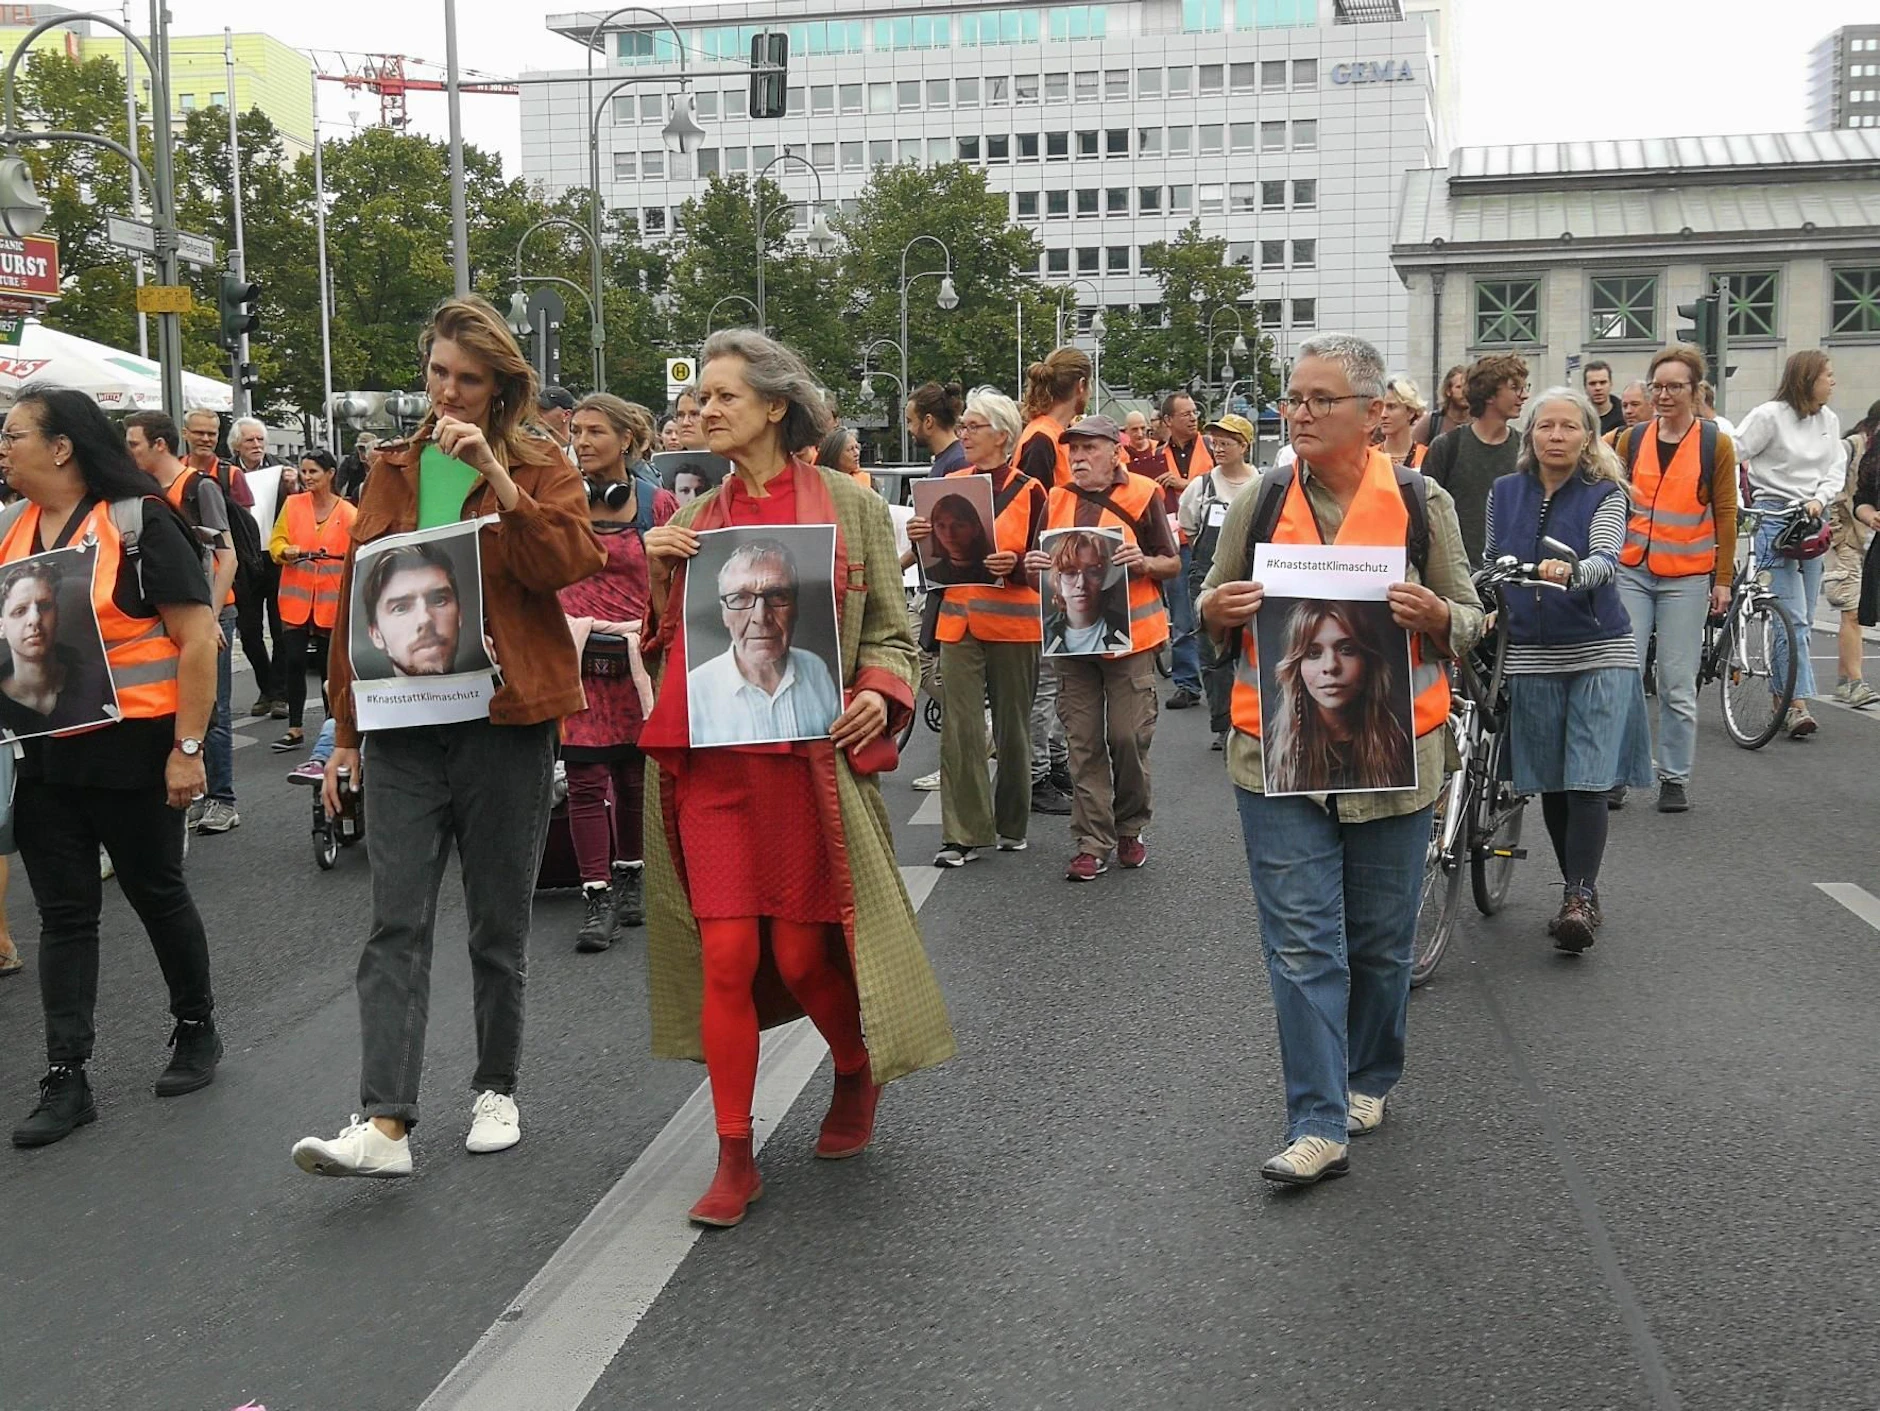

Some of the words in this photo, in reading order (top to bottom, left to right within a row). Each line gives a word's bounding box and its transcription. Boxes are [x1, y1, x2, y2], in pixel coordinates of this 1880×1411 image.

[1331, 60, 1414, 84] GEMA
[1, 252, 48, 277] URST
[0, 320, 17, 332] RST
[676, 366, 685, 377] H
[1266, 558, 1389, 573] #KnaststattKlimaschutz
[366, 690, 481, 704] #KnaststattKlimaschutz
